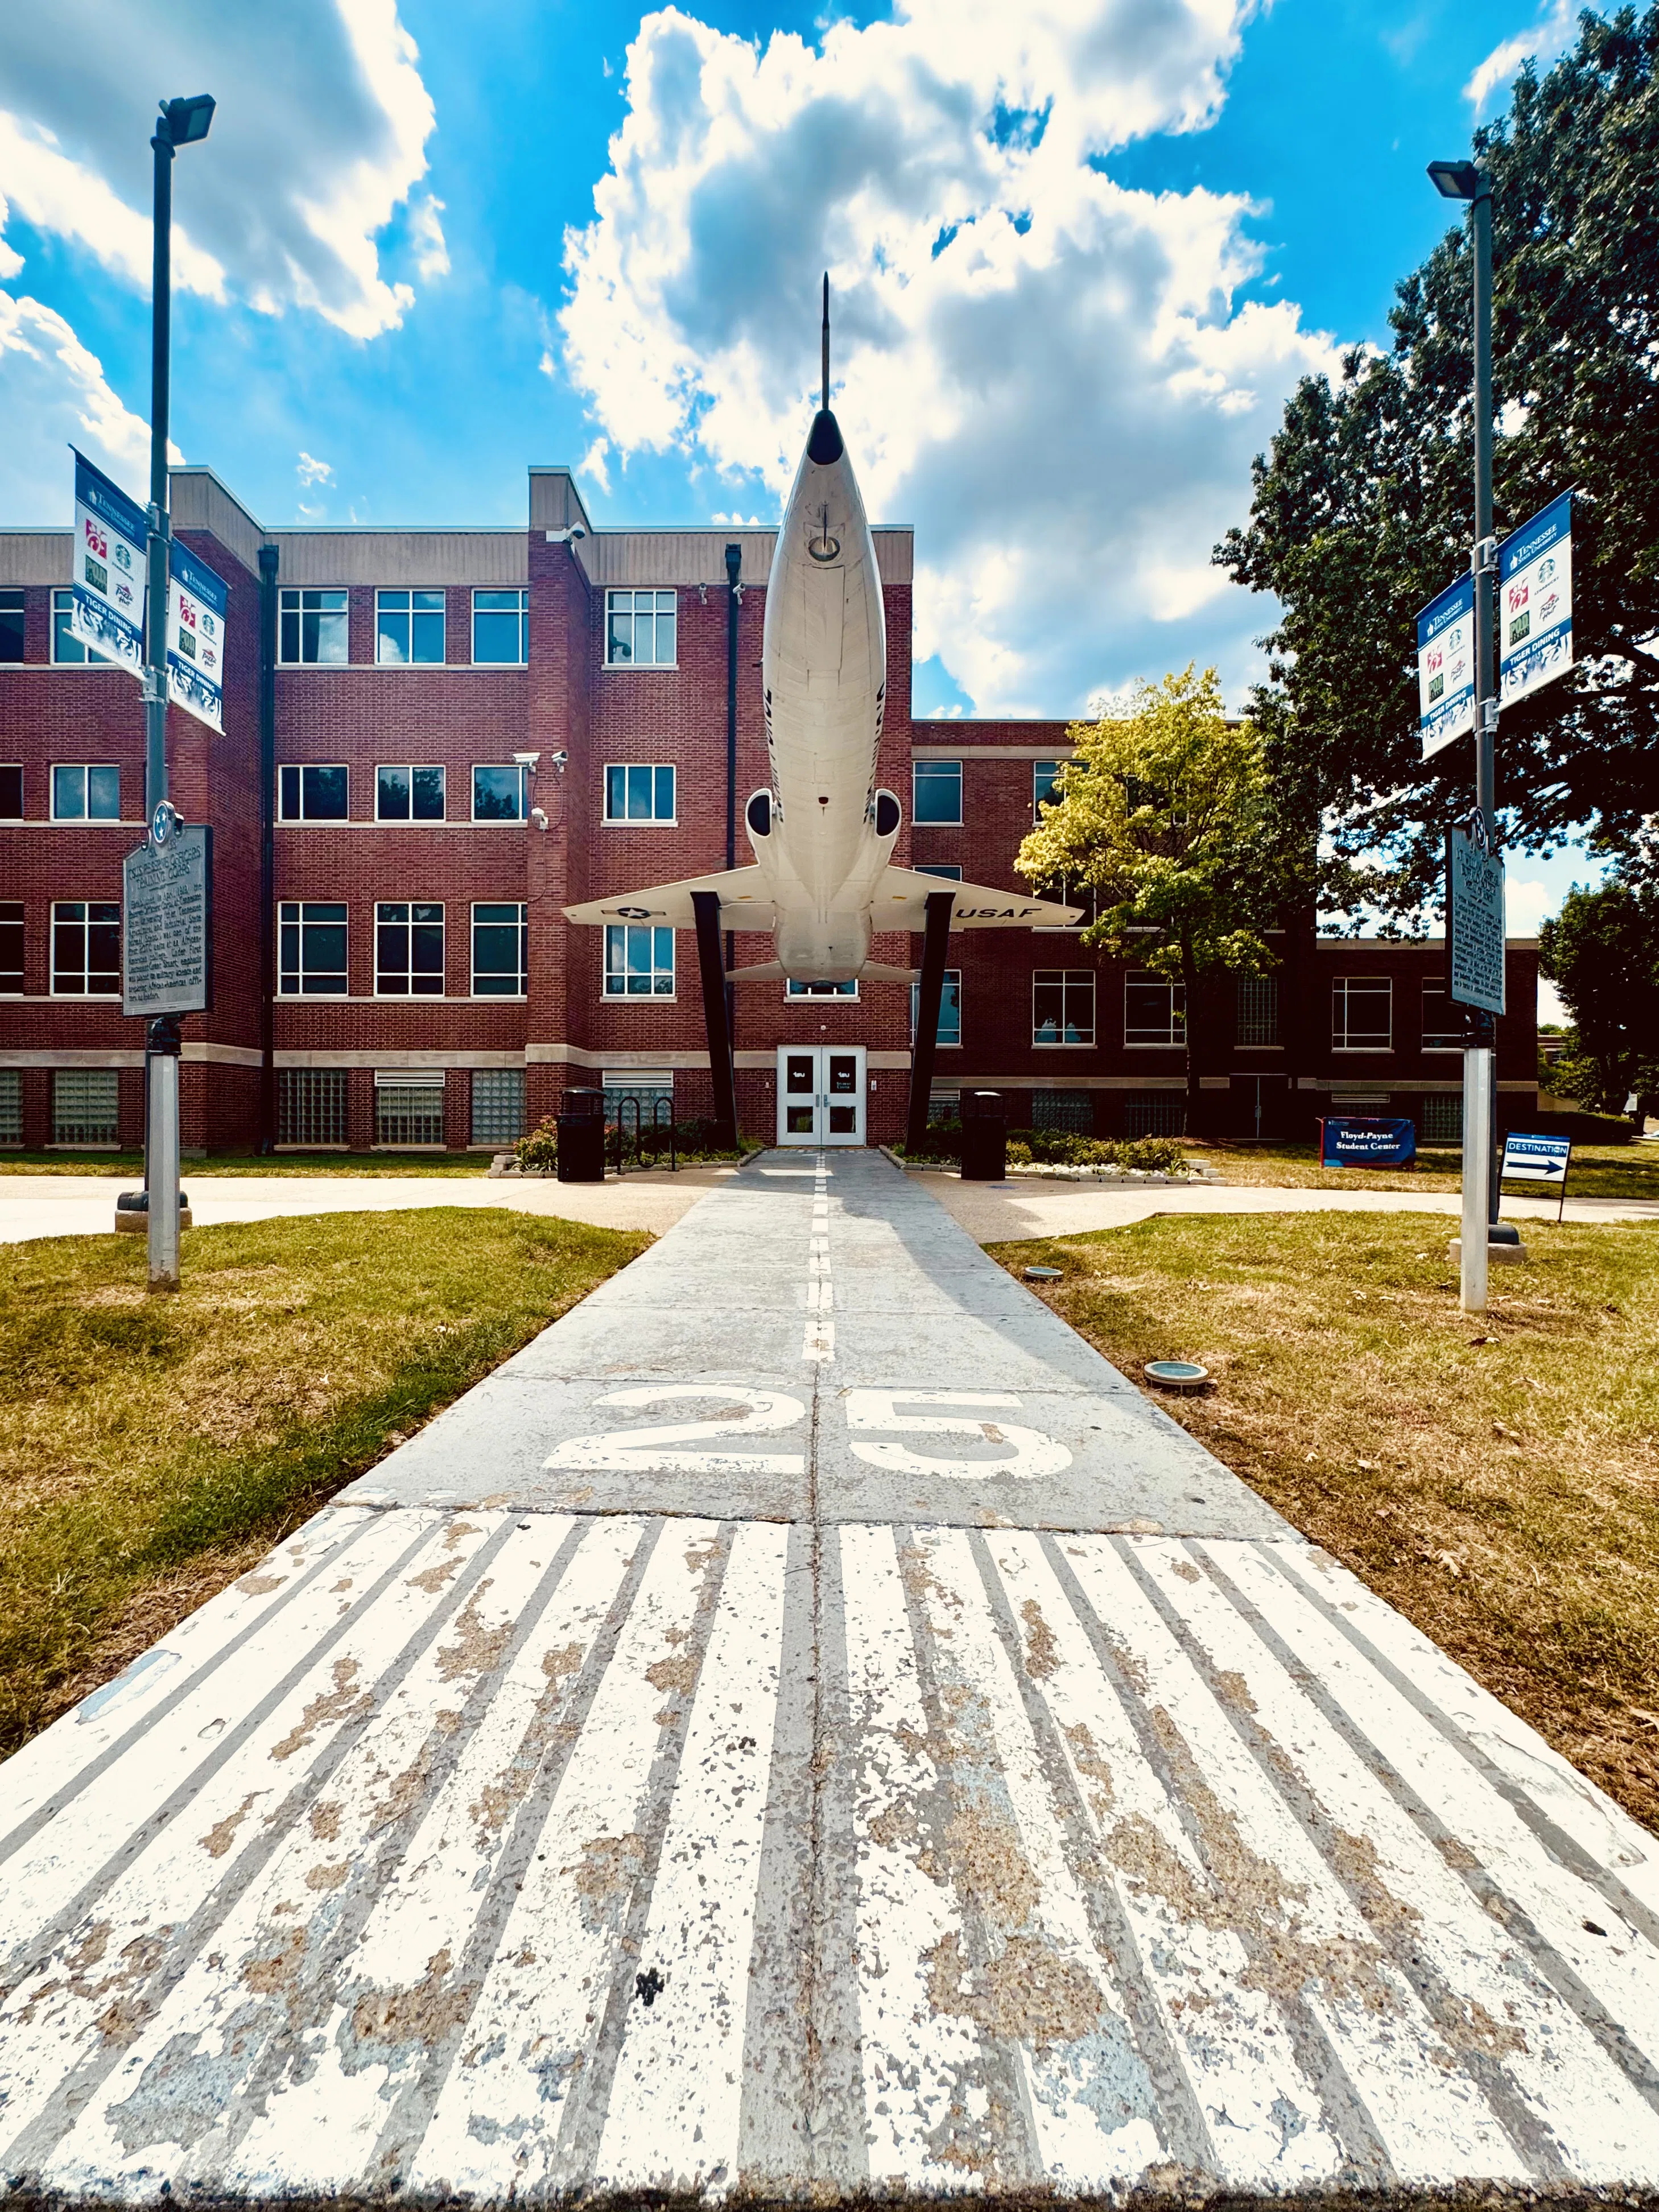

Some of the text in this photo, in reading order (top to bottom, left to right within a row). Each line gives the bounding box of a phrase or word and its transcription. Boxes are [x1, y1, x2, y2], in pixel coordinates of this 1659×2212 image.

[1516, 523, 1558, 558] TENNESSEE
[85, 594, 133, 635] TIGER DINING
[1509, 647, 1530, 666] TIGER
[1532, 628, 1560, 652] DINING
[178, 661, 216, 693] TIGER DINING
[1429, 705, 1445, 721] TIGER
[1445, 689, 1467, 711] DINING
[956, 908, 1042, 918] USAF
[1336, 1141, 1368, 1150] Student
[1340, 1131, 1394, 1141] Floyd-Payne
[1509, 1142, 1566, 1154] DESTINATION
